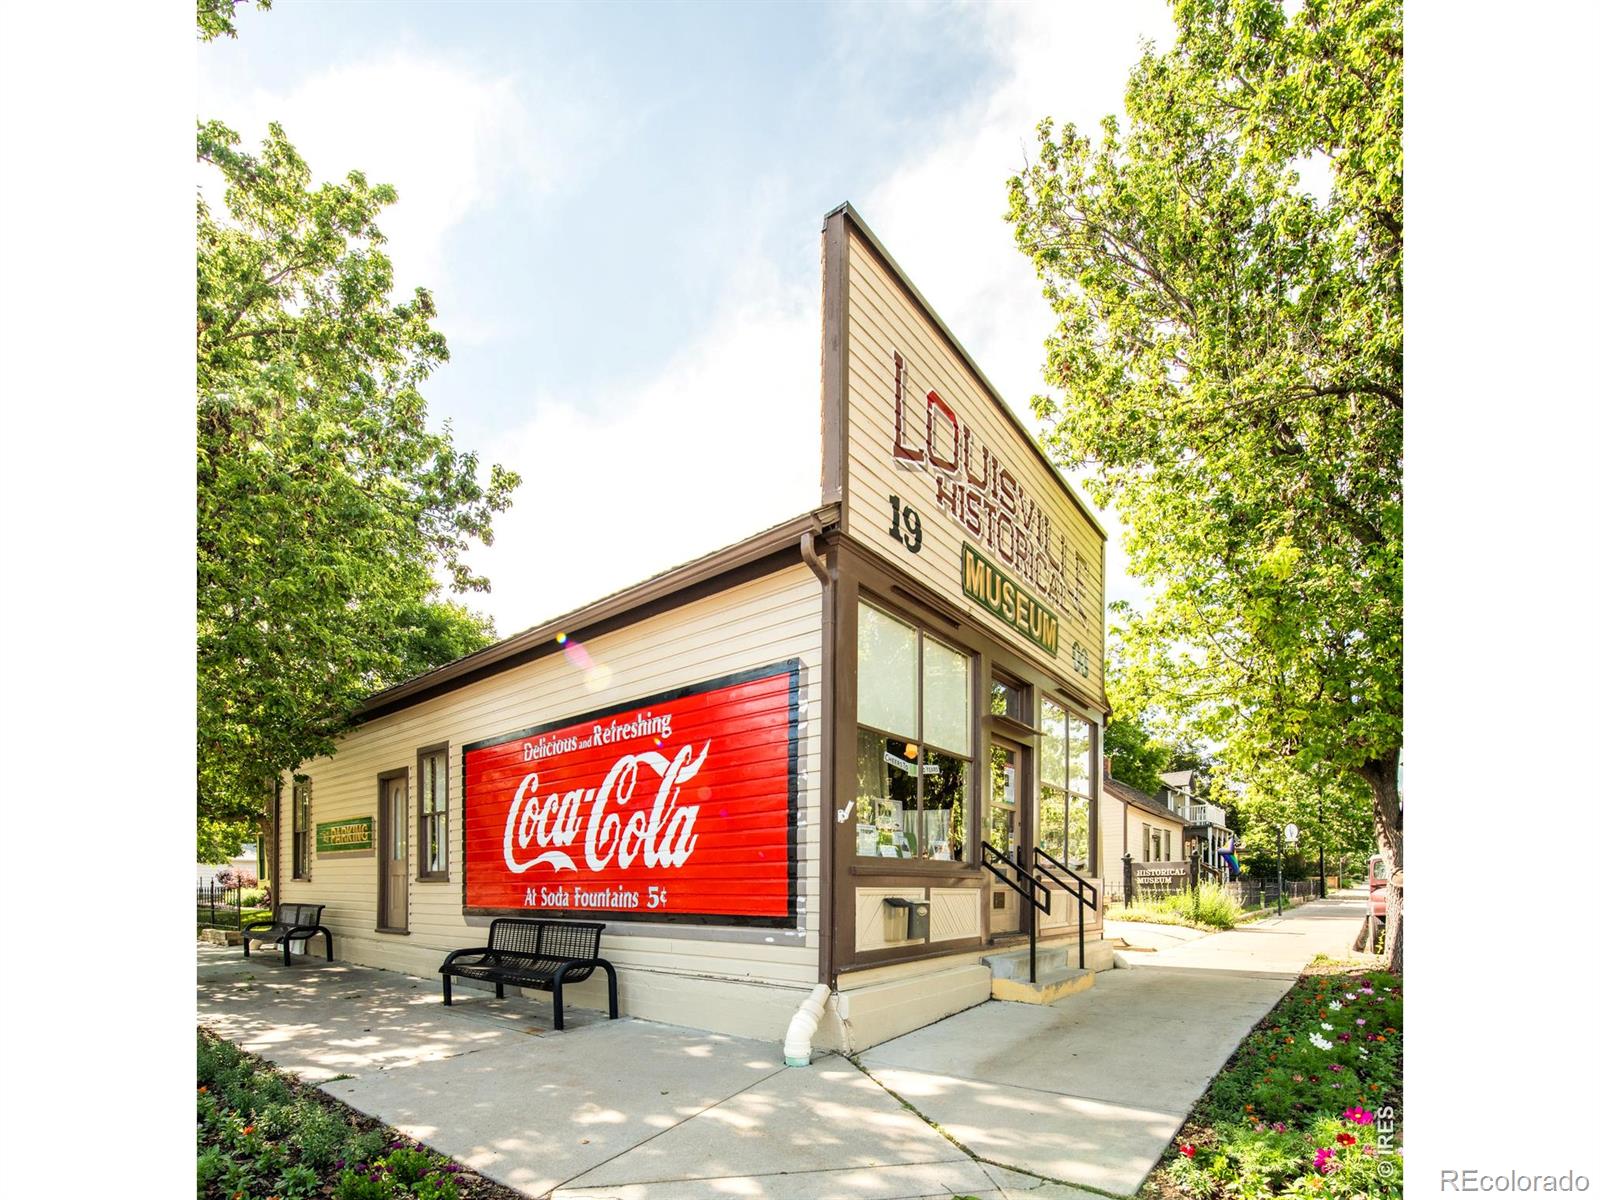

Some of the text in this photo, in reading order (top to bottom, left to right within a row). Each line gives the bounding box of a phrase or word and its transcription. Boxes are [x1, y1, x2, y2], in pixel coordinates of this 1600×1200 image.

[893, 350, 1088, 631] LOUISVILLE
[889, 494, 923, 553] 19
[936, 475, 1072, 617] HISTORICAL
[966, 548, 1058, 650] MUSEUM
[523, 712, 673, 762] Delicious and Refreshing
[331, 824, 369, 844] PARKING
[503, 738, 711, 874] Coca-Cola
[524, 885, 668, 909] At Soda Fountains 5¢
[1136, 868, 1187, 877] HISTORICAL
